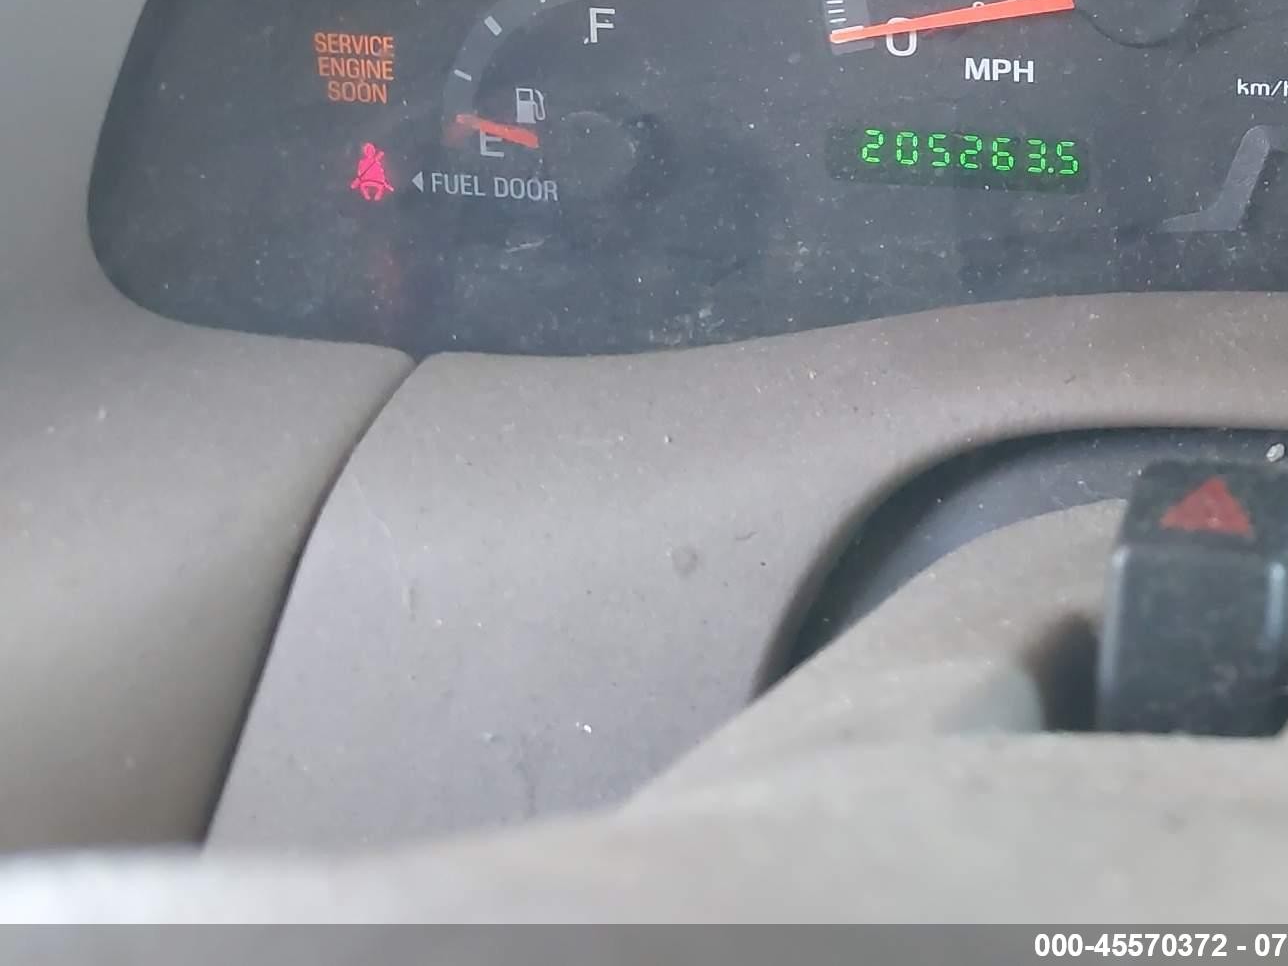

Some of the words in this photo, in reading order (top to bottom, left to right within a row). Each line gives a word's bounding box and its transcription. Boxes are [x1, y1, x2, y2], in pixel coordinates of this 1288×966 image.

[590, 8, 615, 43] F
[315, 33, 393, 56] SERVICE
[320, 57, 393, 80] ENGINE
[964, 57, 1035, 83] MPH
[329, 81, 386, 103] SOON
[862, 130, 1078, 174] 205263.5
[432, 173, 486, 196] FUEL
[494, 177, 557, 201] DOOR
